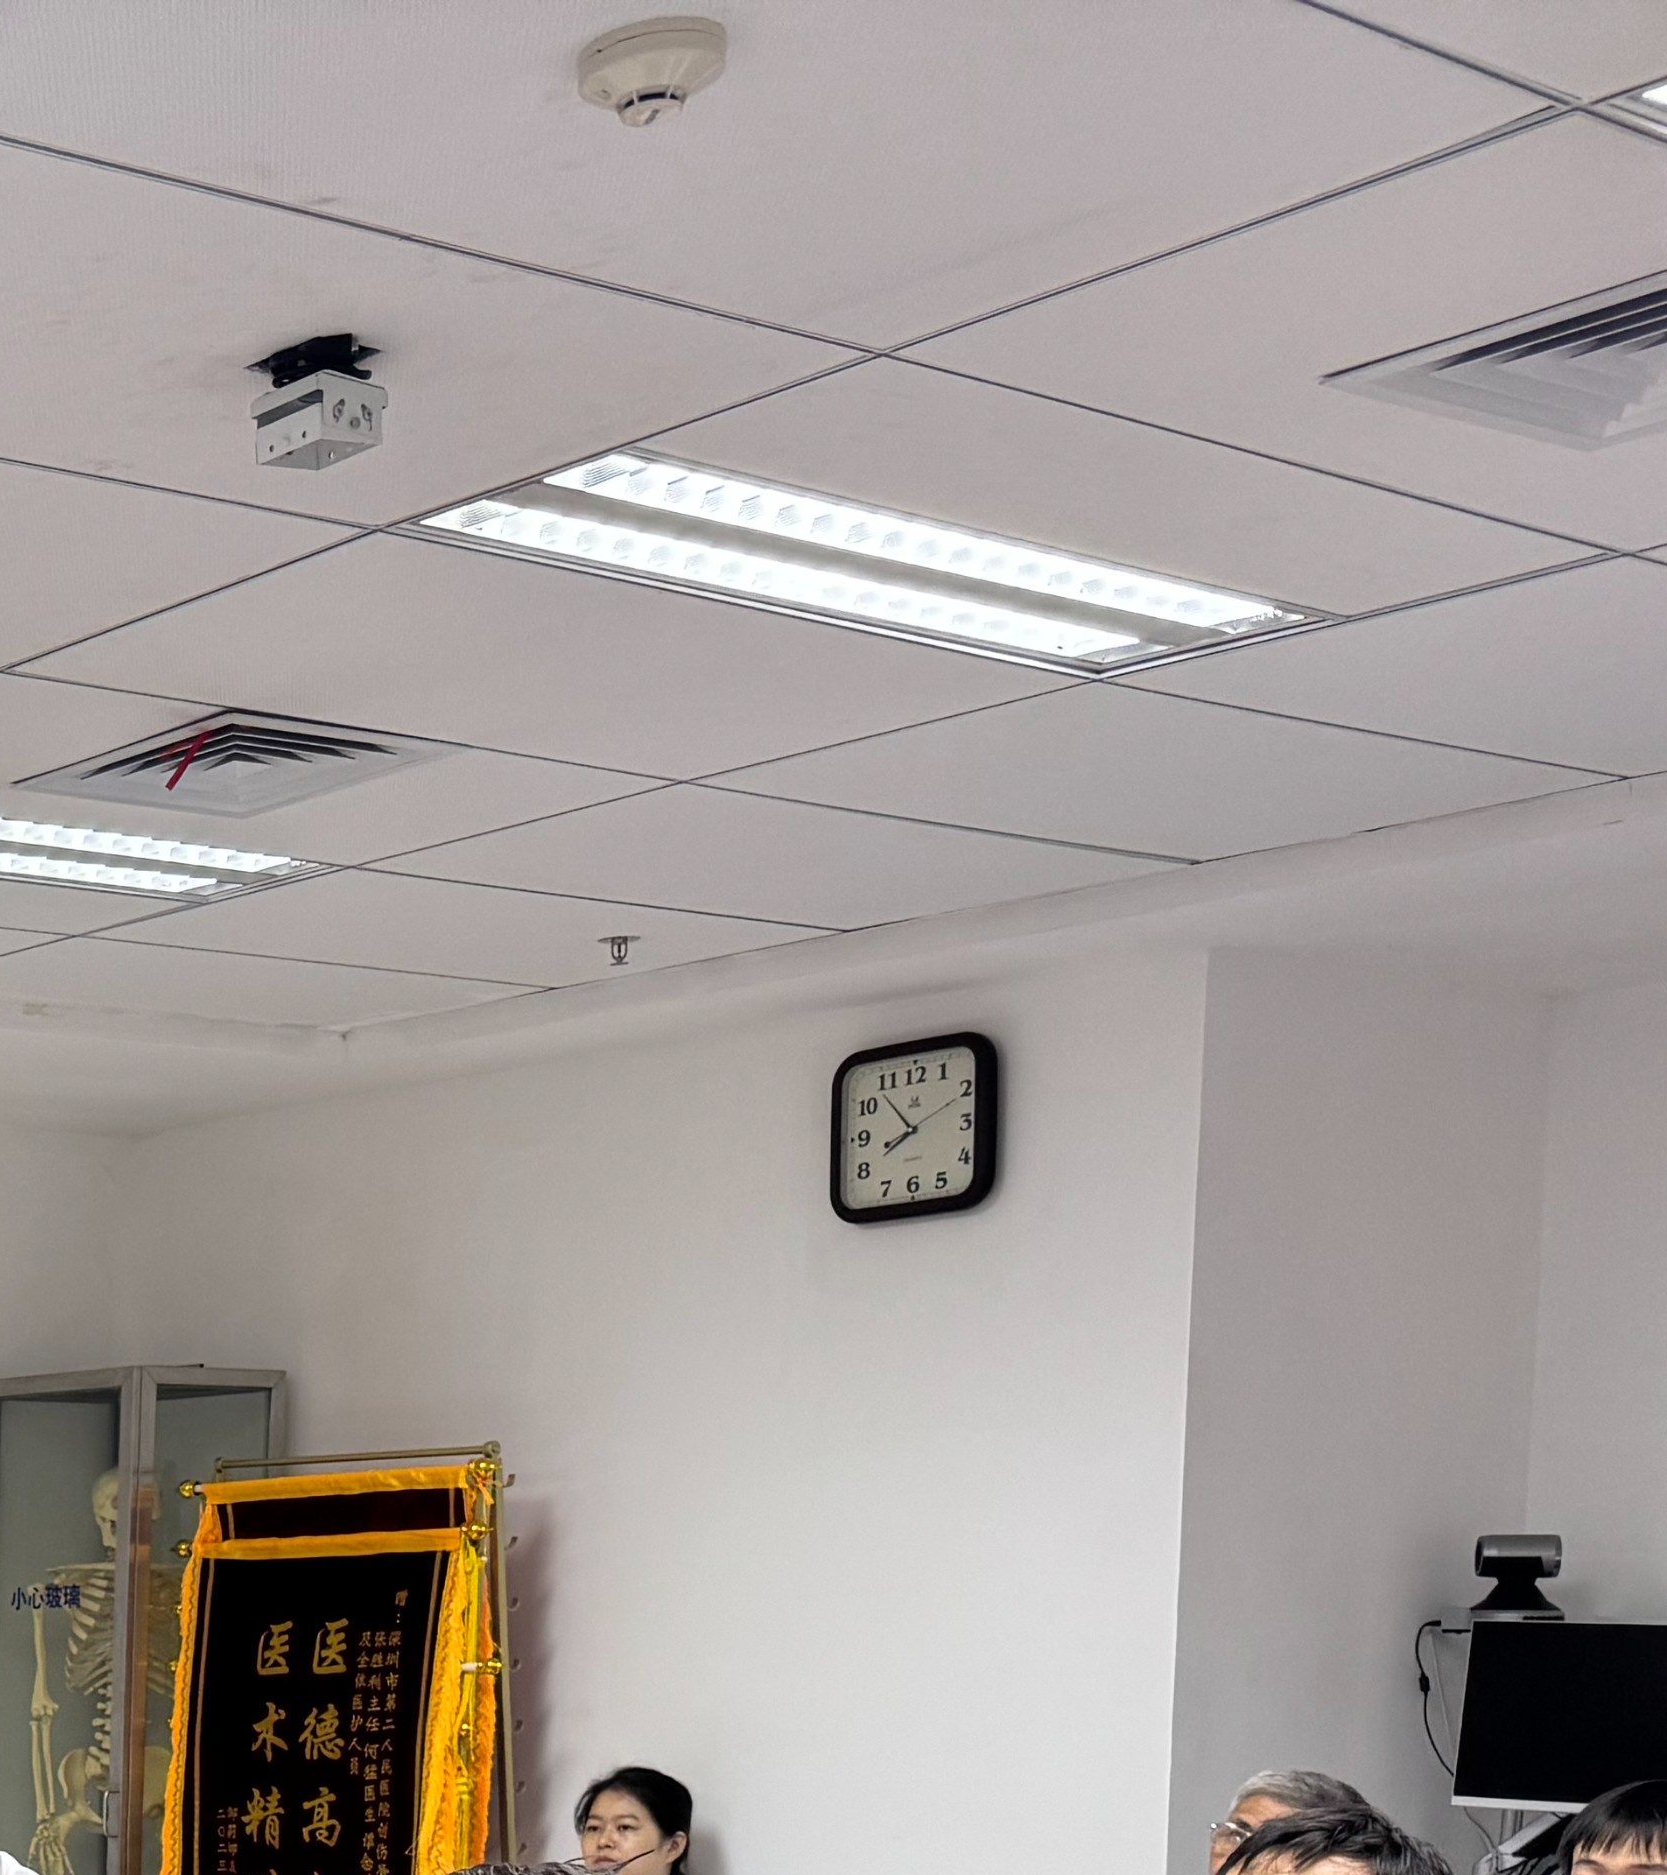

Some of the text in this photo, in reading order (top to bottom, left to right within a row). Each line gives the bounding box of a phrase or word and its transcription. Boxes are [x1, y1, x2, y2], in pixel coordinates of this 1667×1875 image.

[905, 1065, 927, 1086] 12
[938, 1062, 948, 1081] 1
[878, 1072, 897, 1091] 11
[959, 1079, 973, 1098] 2
[858, 1097, 878, 1117] 10
[959, 1113, 972, 1131] 3
[857, 1129, 871, 1148] 9
[957, 1147, 972, 1165] 4
[856, 1162, 871, 1180] 8
[935, 1171, 948, 1190] 5
[880, 1179, 892, 1198] 7
[906, 1175, 920, 1194] 6
